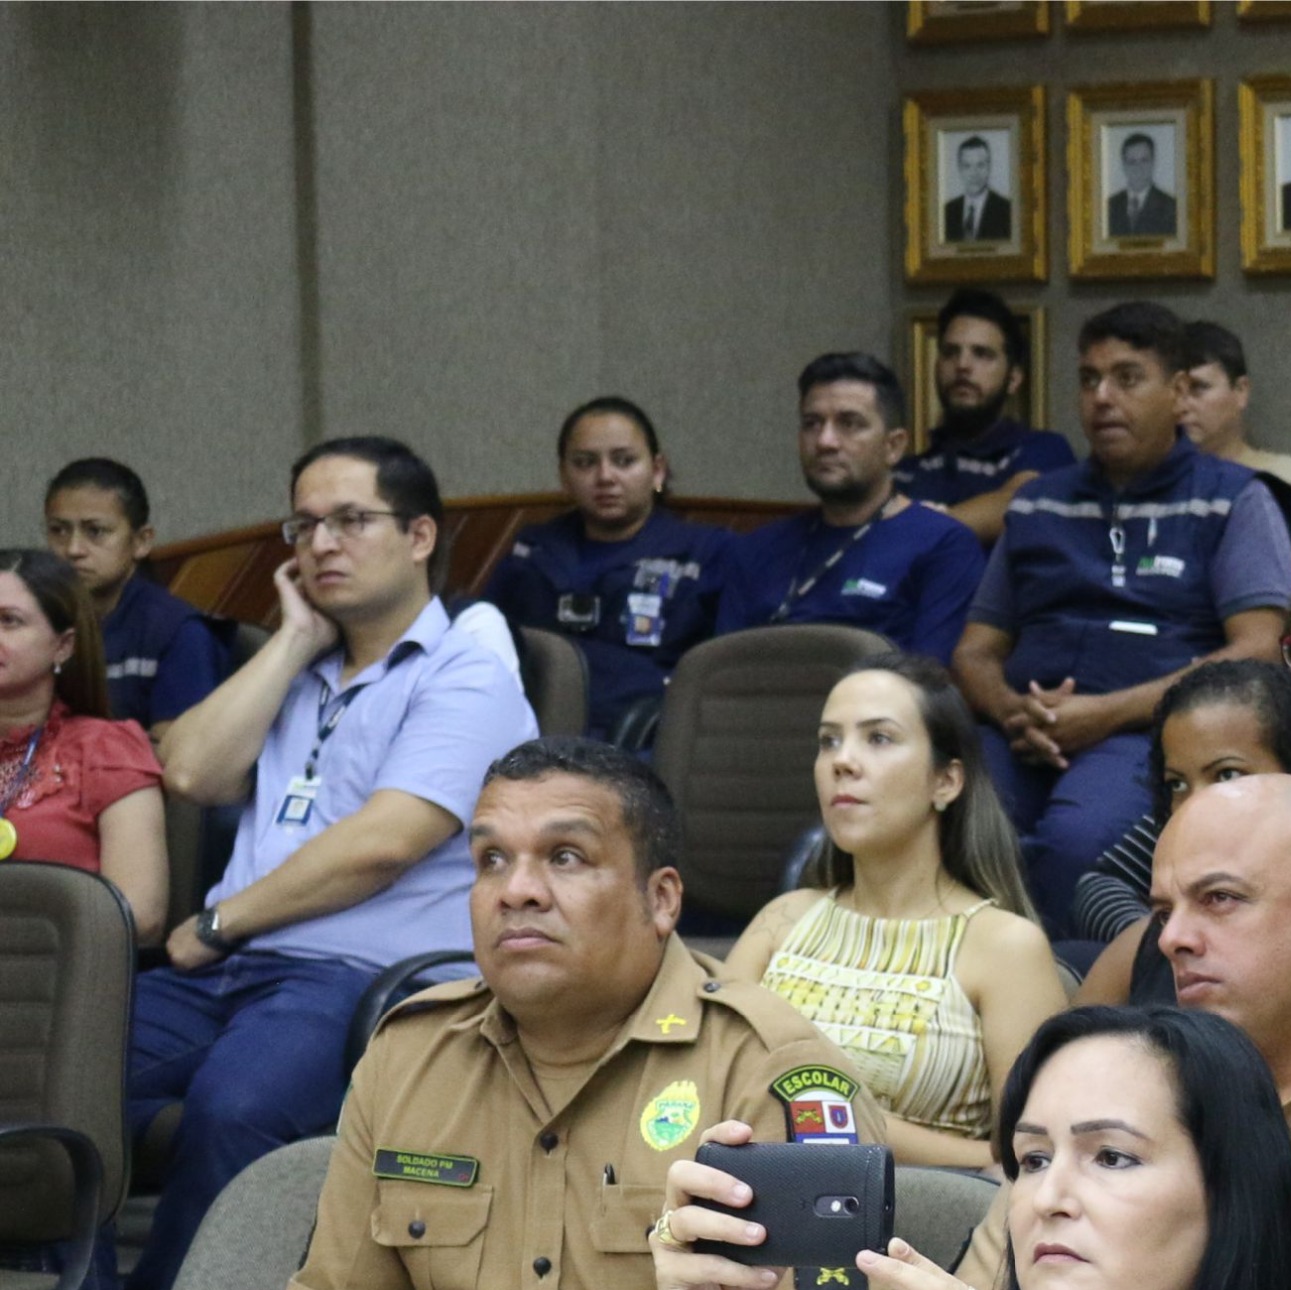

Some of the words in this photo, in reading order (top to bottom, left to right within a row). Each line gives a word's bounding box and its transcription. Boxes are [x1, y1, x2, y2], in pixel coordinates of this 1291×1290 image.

[782, 1070, 850, 1096] ESCOLAR
[396, 1154, 438, 1169] SOLDADO
[403, 1165, 440, 1178] MACENA
